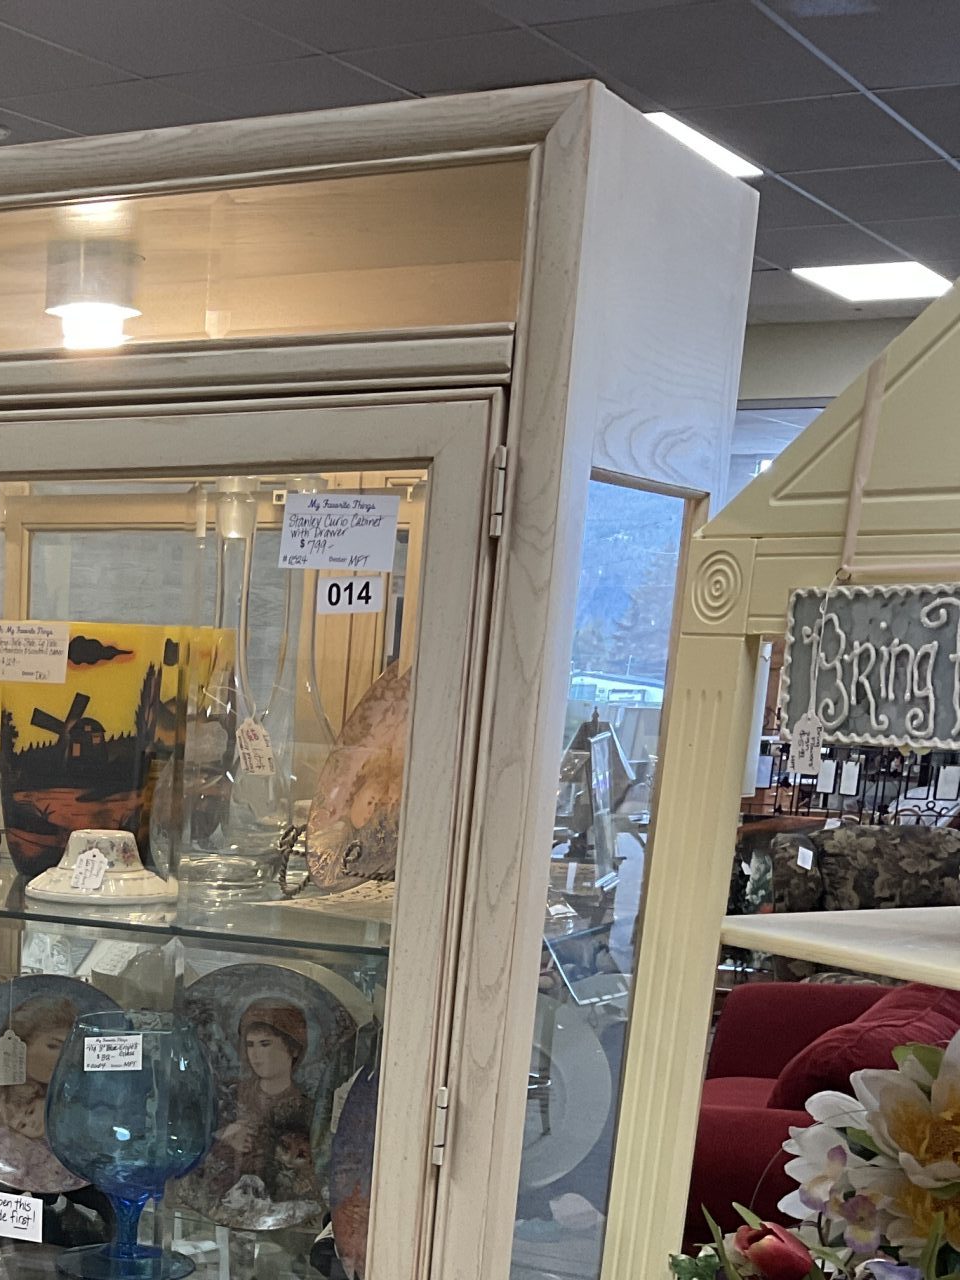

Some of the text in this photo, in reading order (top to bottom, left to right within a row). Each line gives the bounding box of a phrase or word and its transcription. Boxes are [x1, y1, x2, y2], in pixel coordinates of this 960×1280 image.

[308, 500, 375, 511] My Favorite Things
[290, 513, 382, 528] Stanley Curio Cabinet
[291, 527, 348, 538] with Drawer
[327, 581, 372, 606] 014
[14, 1197, 31, 1211] this
